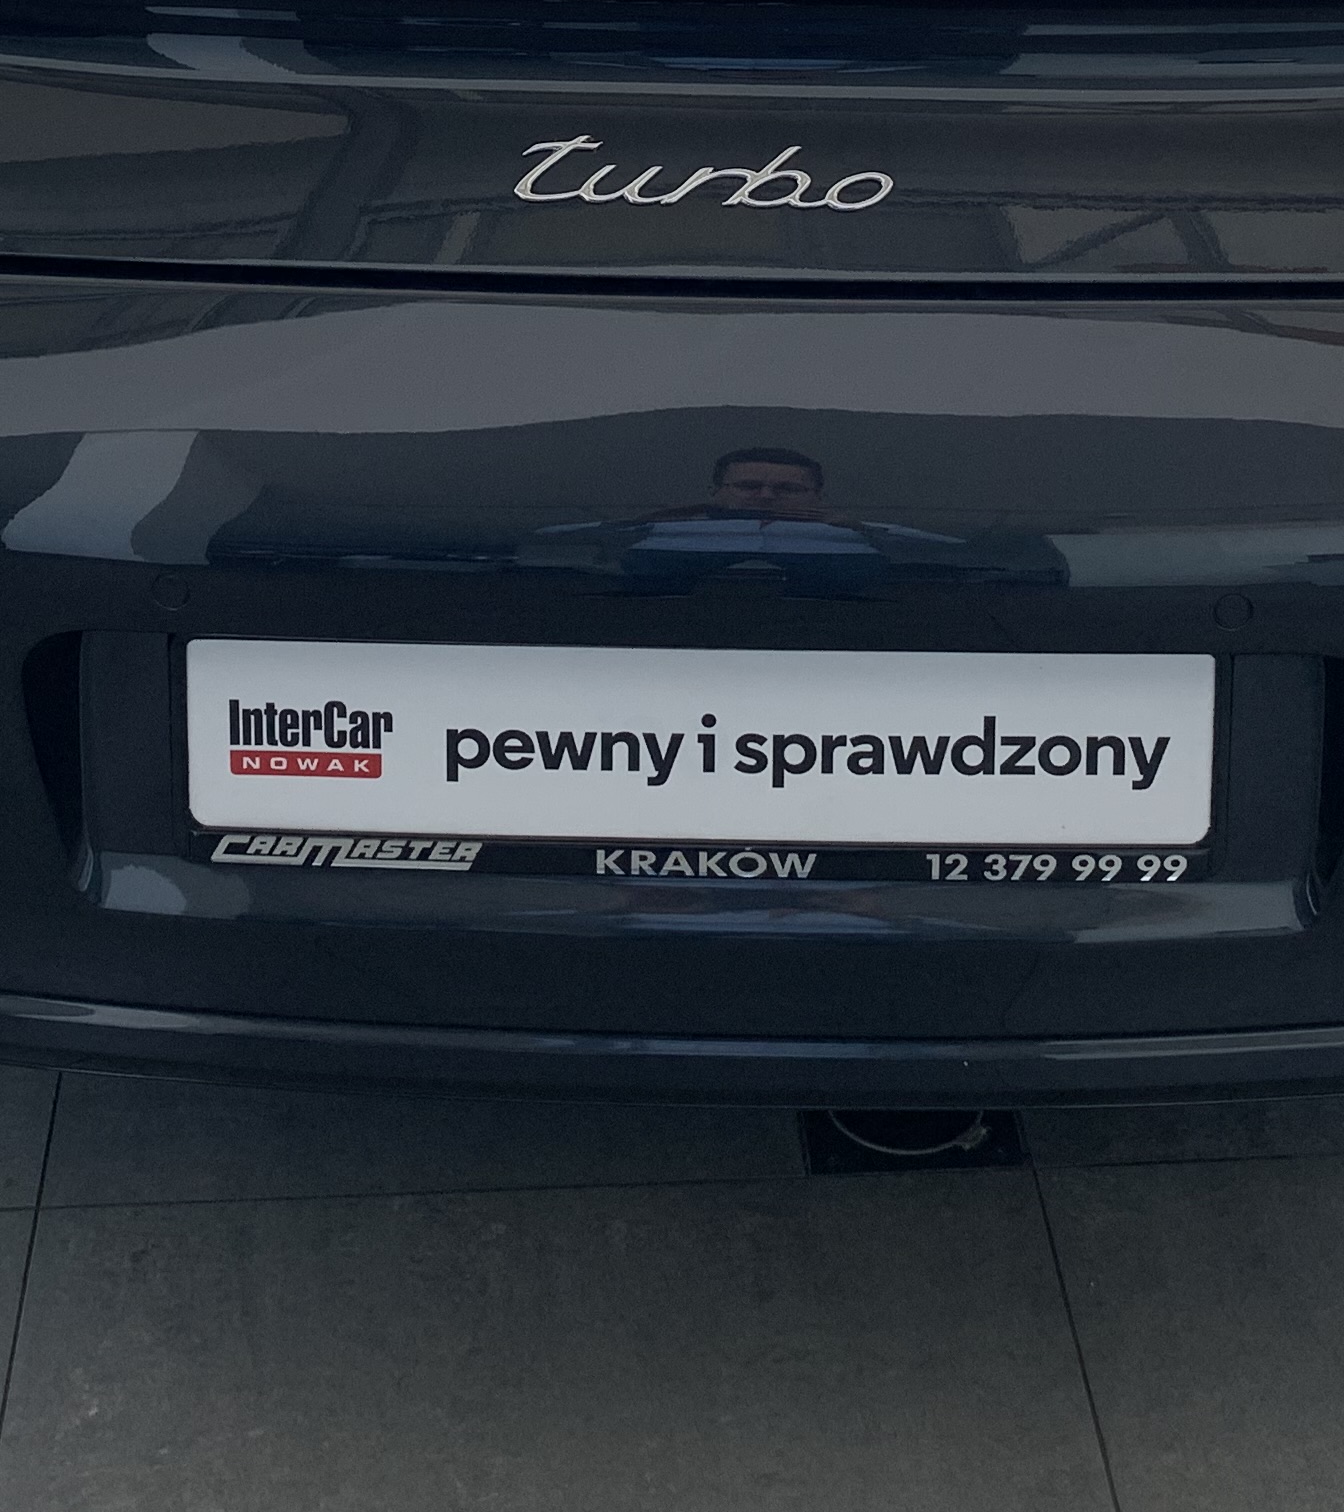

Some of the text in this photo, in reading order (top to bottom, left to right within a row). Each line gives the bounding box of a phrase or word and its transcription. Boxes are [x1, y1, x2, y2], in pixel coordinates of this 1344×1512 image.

[513, 135, 894, 211] turbo
[229, 699, 393, 750] InterCar
[242, 756, 370, 773] NOWAK
[446, 713, 1171, 790] pewny i sprawdzony
[211, 834, 483, 871] CARMASTER
[926, 853, 968, 881] 12
[983, 854, 1056, 881] 379
[1071, 854, 1123, 881] 99
[1136, 854, 1188, 882] 99
